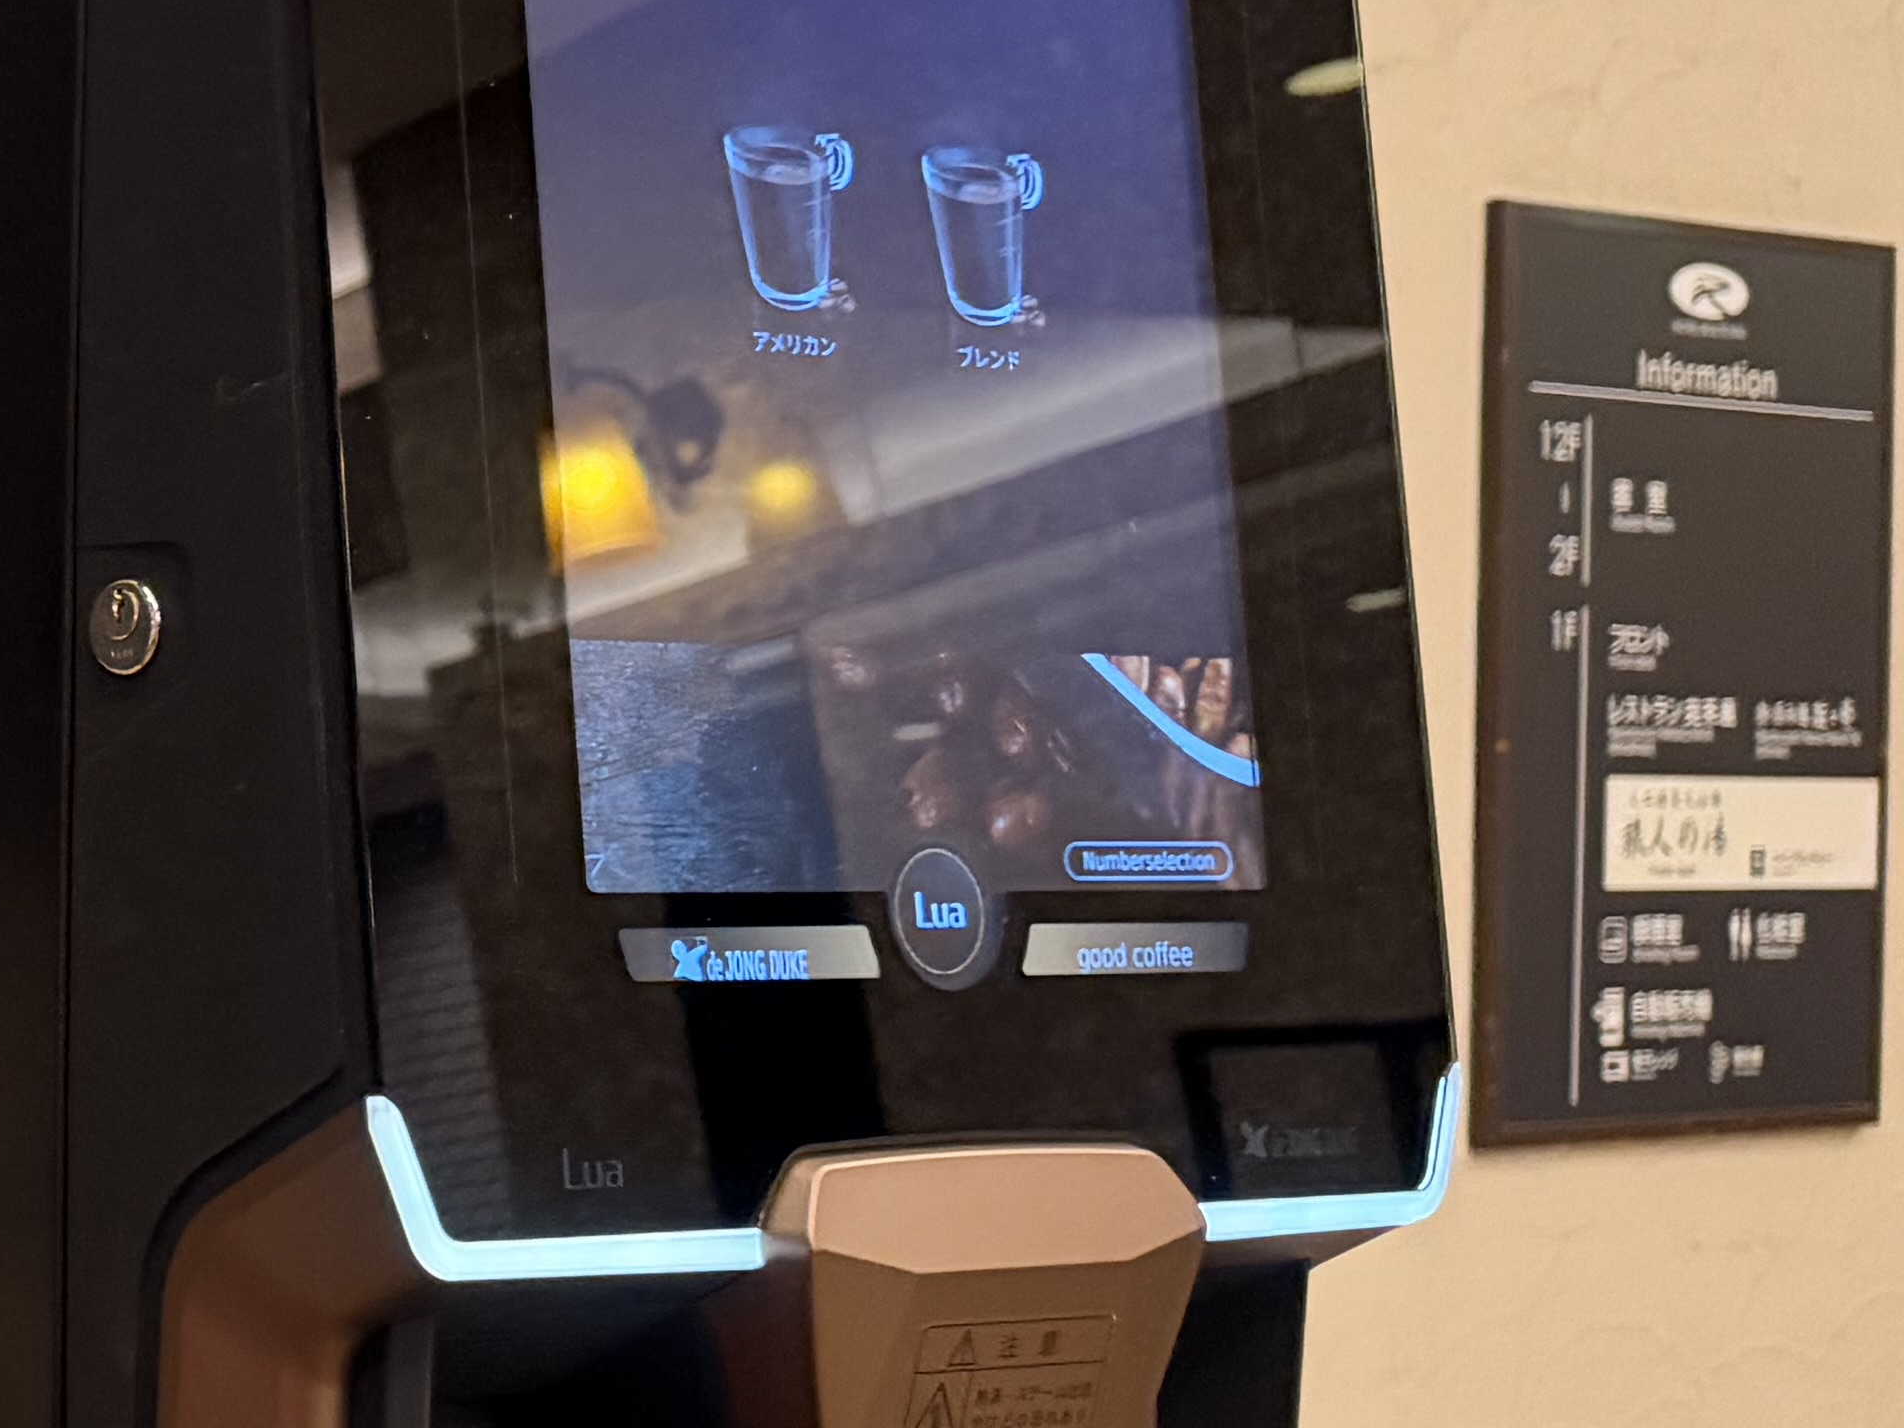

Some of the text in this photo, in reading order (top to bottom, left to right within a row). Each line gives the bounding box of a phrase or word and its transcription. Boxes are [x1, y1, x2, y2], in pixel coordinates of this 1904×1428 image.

[753, 331, 837, 357] アメリカン
[956, 346, 1020, 370] ブレンド
[1636, 350, 1778, 400] Information
[1540, 419, 1581, 461] 12F
[1549, 534, 1579, 576] 2F
[1082, 851, 1215, 872] Numberselection
[913, 891, 967, 930] Lua
[725, 950, 766, 980] JONG
[769, 949, 808, 980] DUKE
[1078, 941, 1194, 973] good coffee
[562, 1148, 624, 1190] Lua
